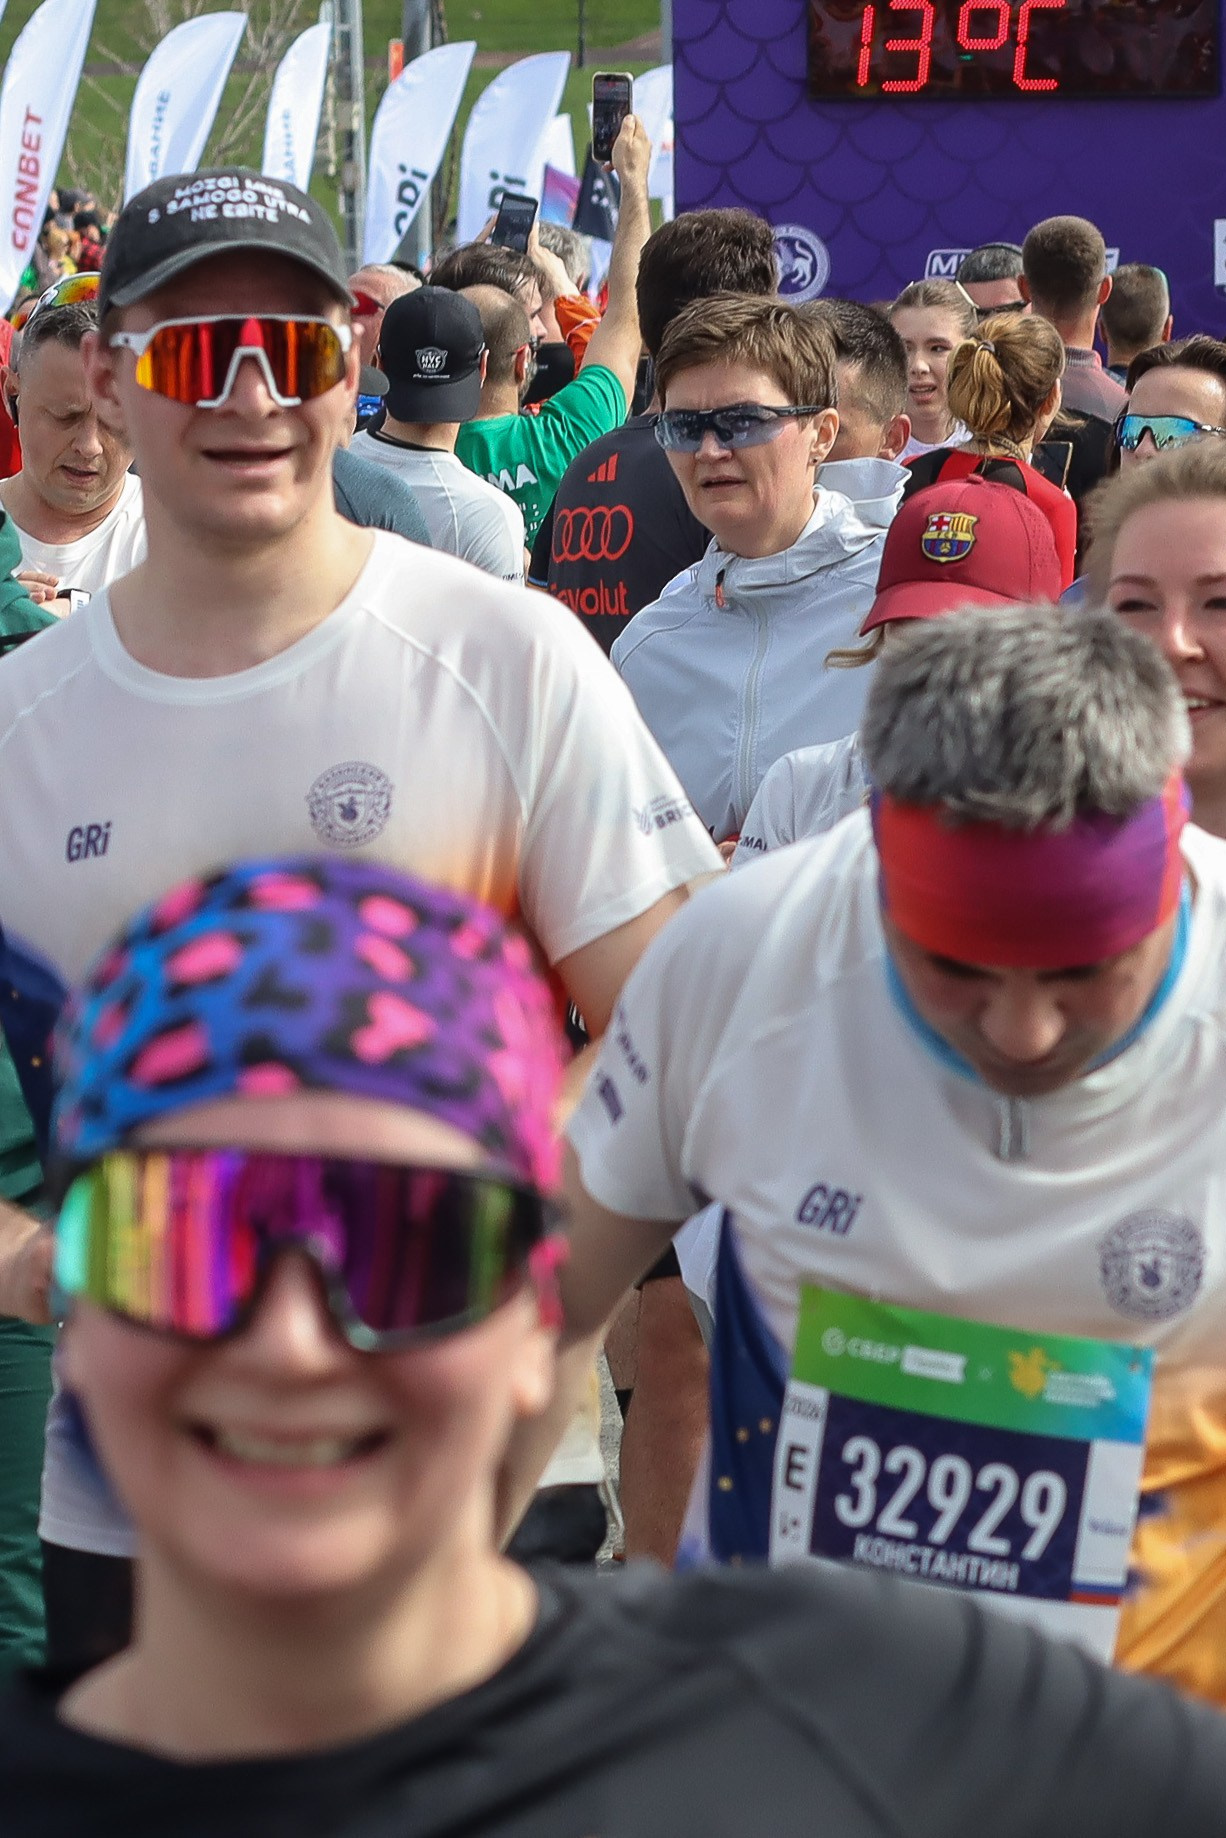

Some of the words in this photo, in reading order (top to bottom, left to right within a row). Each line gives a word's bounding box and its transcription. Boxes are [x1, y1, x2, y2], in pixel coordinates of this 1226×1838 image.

[148, 208, 160, 224] S
[166, 189, 258, 215] SAMOGO
[264, 194, 312, 225] UTRA
[190, 203, 218, 223] NE
[67, 820, 112, 862] GRi
[798, 1184, 863, 1236] GRi
[785, 1442, 807, 1491] E
[834, 1435, 1068, 1562] 32929
[853, 1532, 1021, 1591] КОНСТАНТИН
